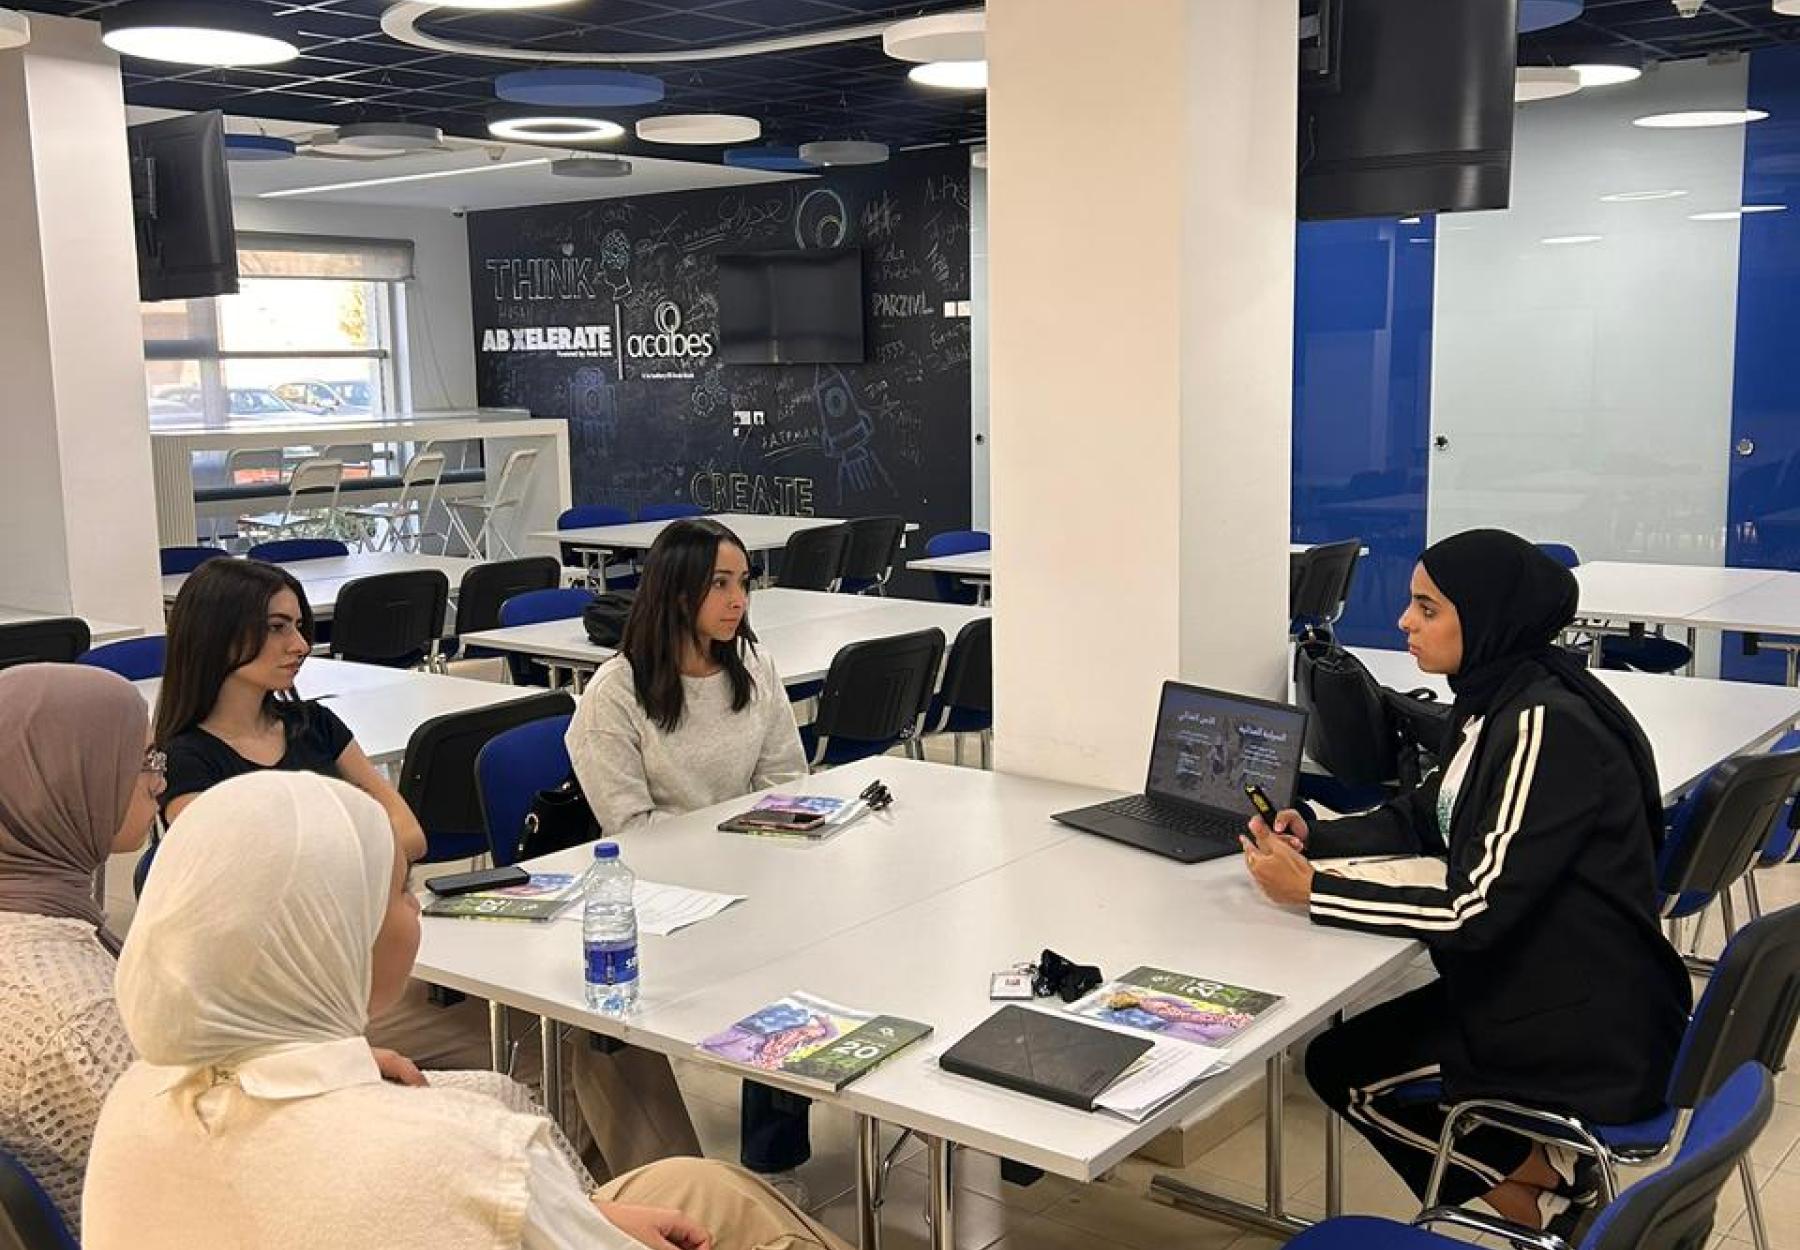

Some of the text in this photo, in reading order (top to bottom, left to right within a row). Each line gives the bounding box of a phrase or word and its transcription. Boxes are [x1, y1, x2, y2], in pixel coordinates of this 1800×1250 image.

[486, 258, 596, 300] THINK
[482, 326, 612, 351] AB XELERATE
[627, 328, 713, 358] acabes
[690, 472, 815, 517] CREATE
